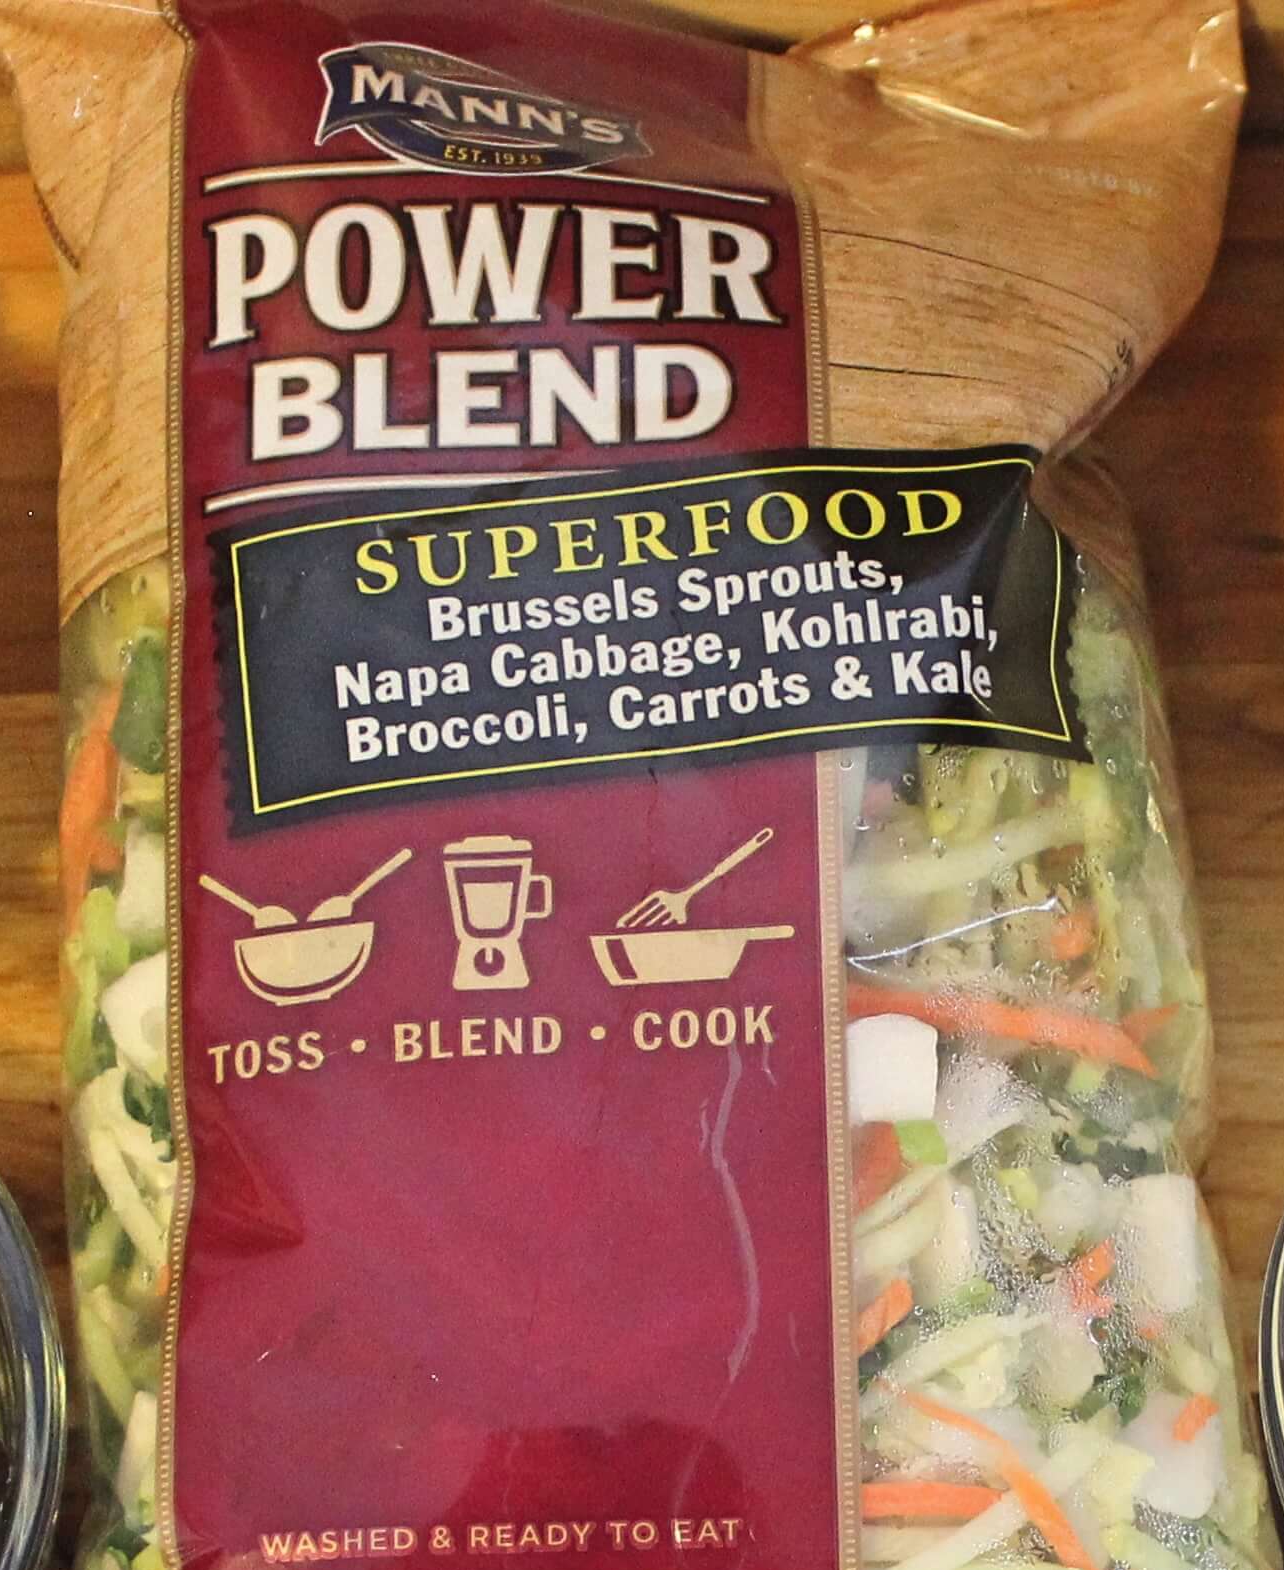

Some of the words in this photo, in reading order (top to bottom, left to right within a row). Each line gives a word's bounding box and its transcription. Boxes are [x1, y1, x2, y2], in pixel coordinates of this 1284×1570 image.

[350, 63, 625, 145] MANN'S
[443, 144, 488, 166] EST.
[208, 203, 782, 349] POWER
[251, 344, 733, 461] BLEND
[354, 488, 963, 597] SUPERFOOD
[427, 579, 657, 643] Brussels
[678, 550, 905, 617] Sprouts,
[334, 657, 471, 713] Napa
[491, 631, 742, 681] Cabbage,
[761, 594, 1000, 654] Kohlrabi,
[345, 702, 589, 764] Broccoli,
[608, 671, 811, 730] Carrots
[830, 656, 875, 701] &
[892, 649, 992, 701] Kale
[208, 1030, 325, 1083] TOSS
[393, 1016, 562, 1064] BLEND
[632, 1004, 775, 1051] COOK
[261, 1527, 415, 1559] WASHED
[431, 1525, 452, 1551] &
[470, 1522, 594, 1551] READY
[609, 1521, 657, 1545] TO
[673, 1518, 743, 1543] EAT
